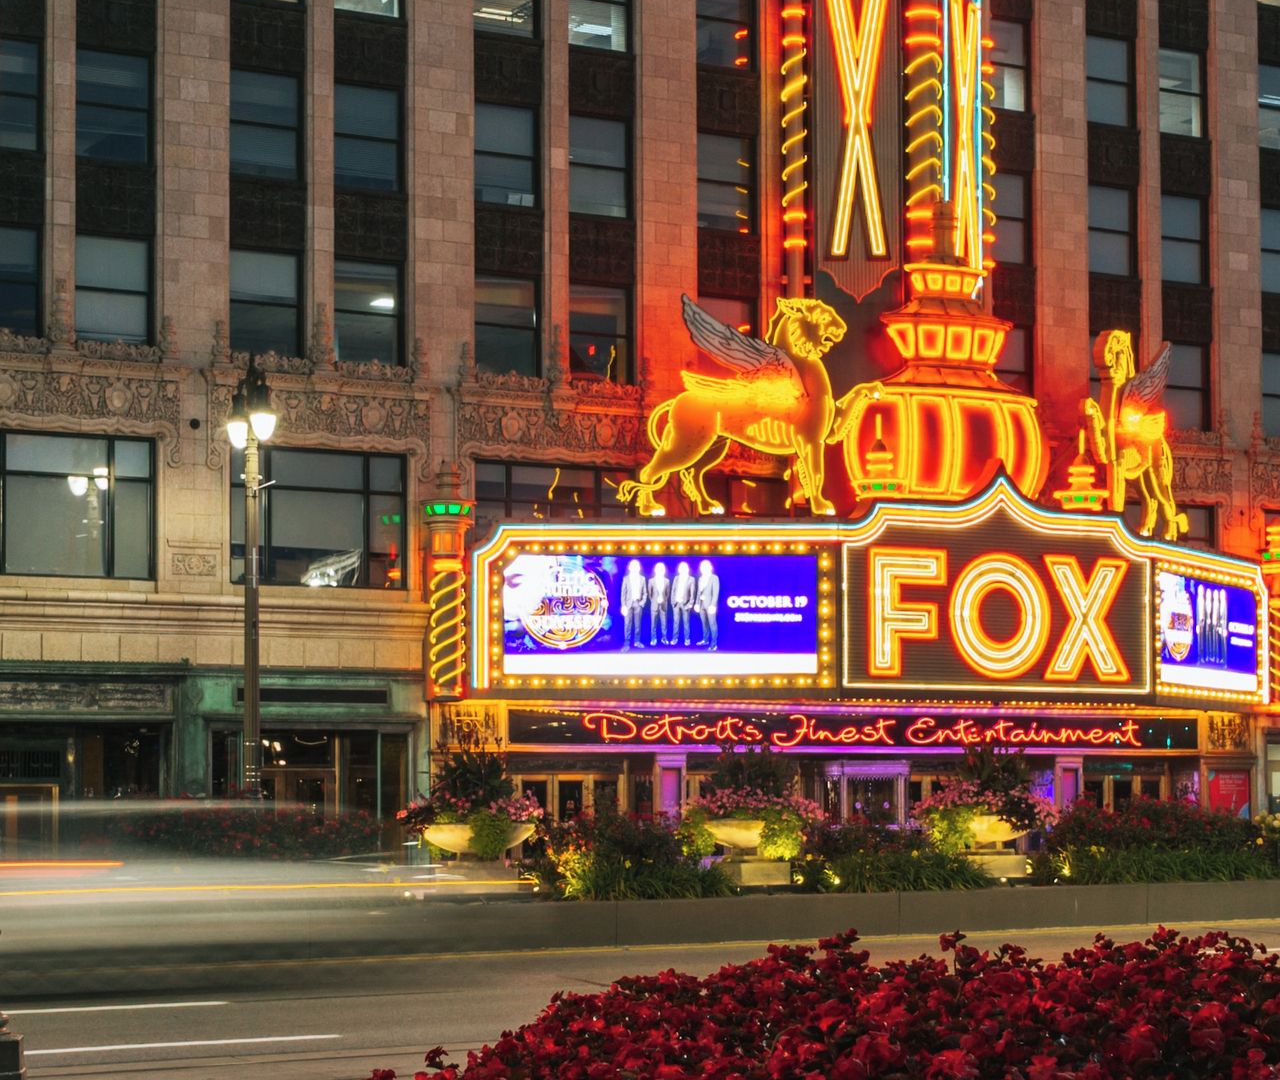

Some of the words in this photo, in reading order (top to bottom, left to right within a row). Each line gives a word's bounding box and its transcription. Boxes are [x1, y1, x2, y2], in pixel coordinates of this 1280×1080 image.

[726, 595, 793, 609] OCTOBER
[868, 547, 1132, 682] FOX
[583, 711, 762, 746] Detroit's
[772, 714, 897, 747] Finest
[906, 717, 1143, 746] Entertainment
